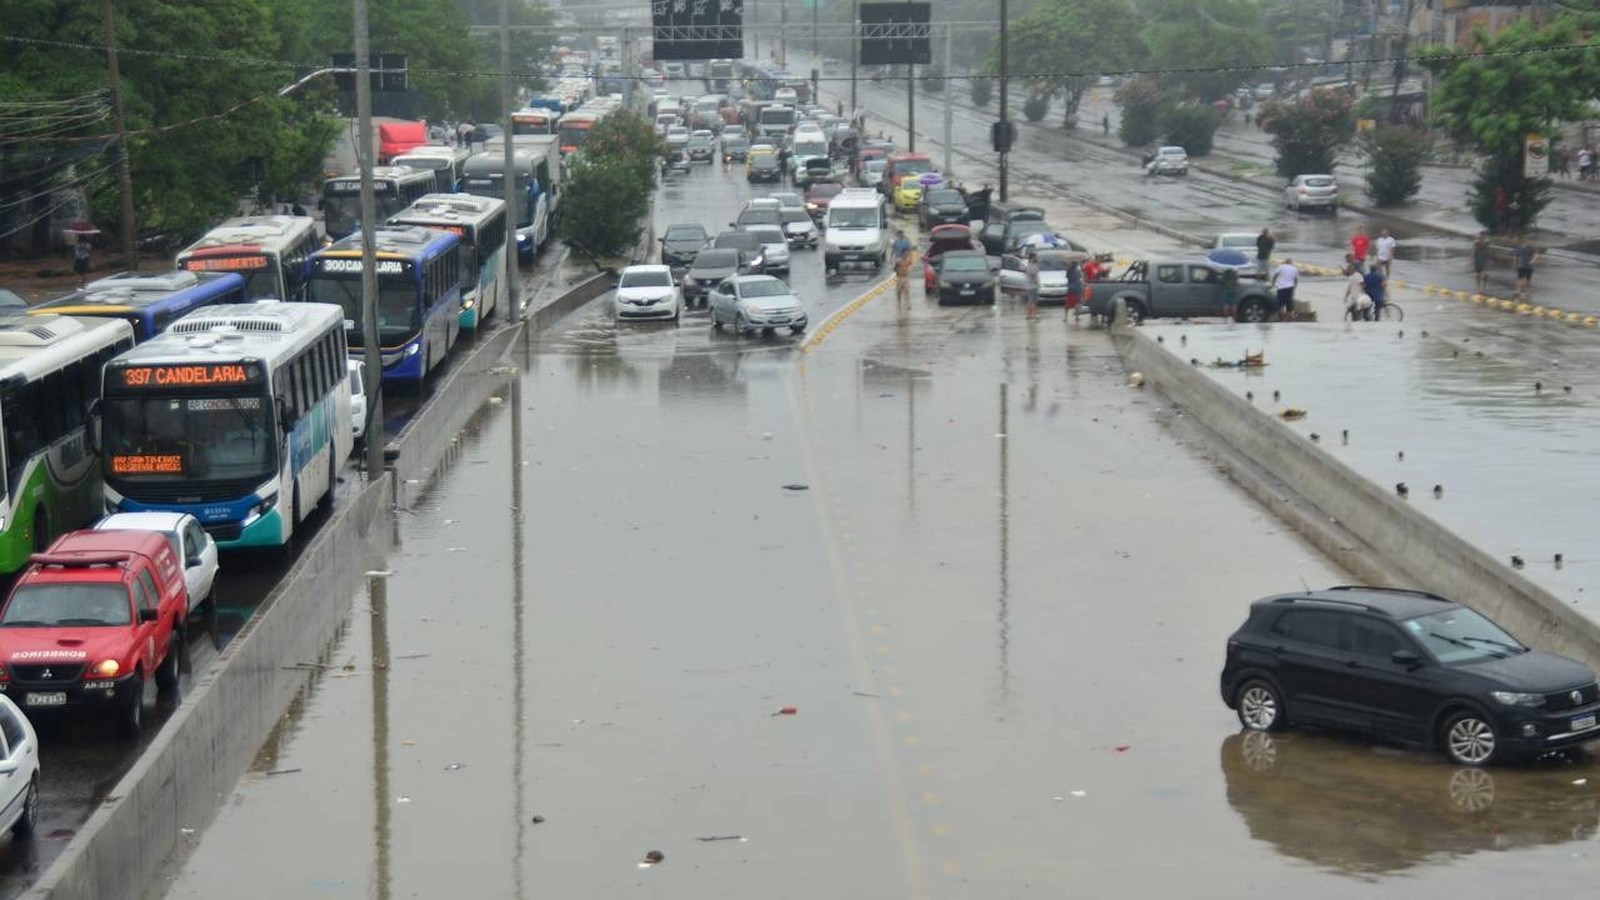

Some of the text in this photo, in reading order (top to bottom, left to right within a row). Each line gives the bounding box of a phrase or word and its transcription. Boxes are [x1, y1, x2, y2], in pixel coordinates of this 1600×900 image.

[325, 260, 402, 272] 300 CANLARIA
[126, 365, 246, 384] 397 CANDELARIA
